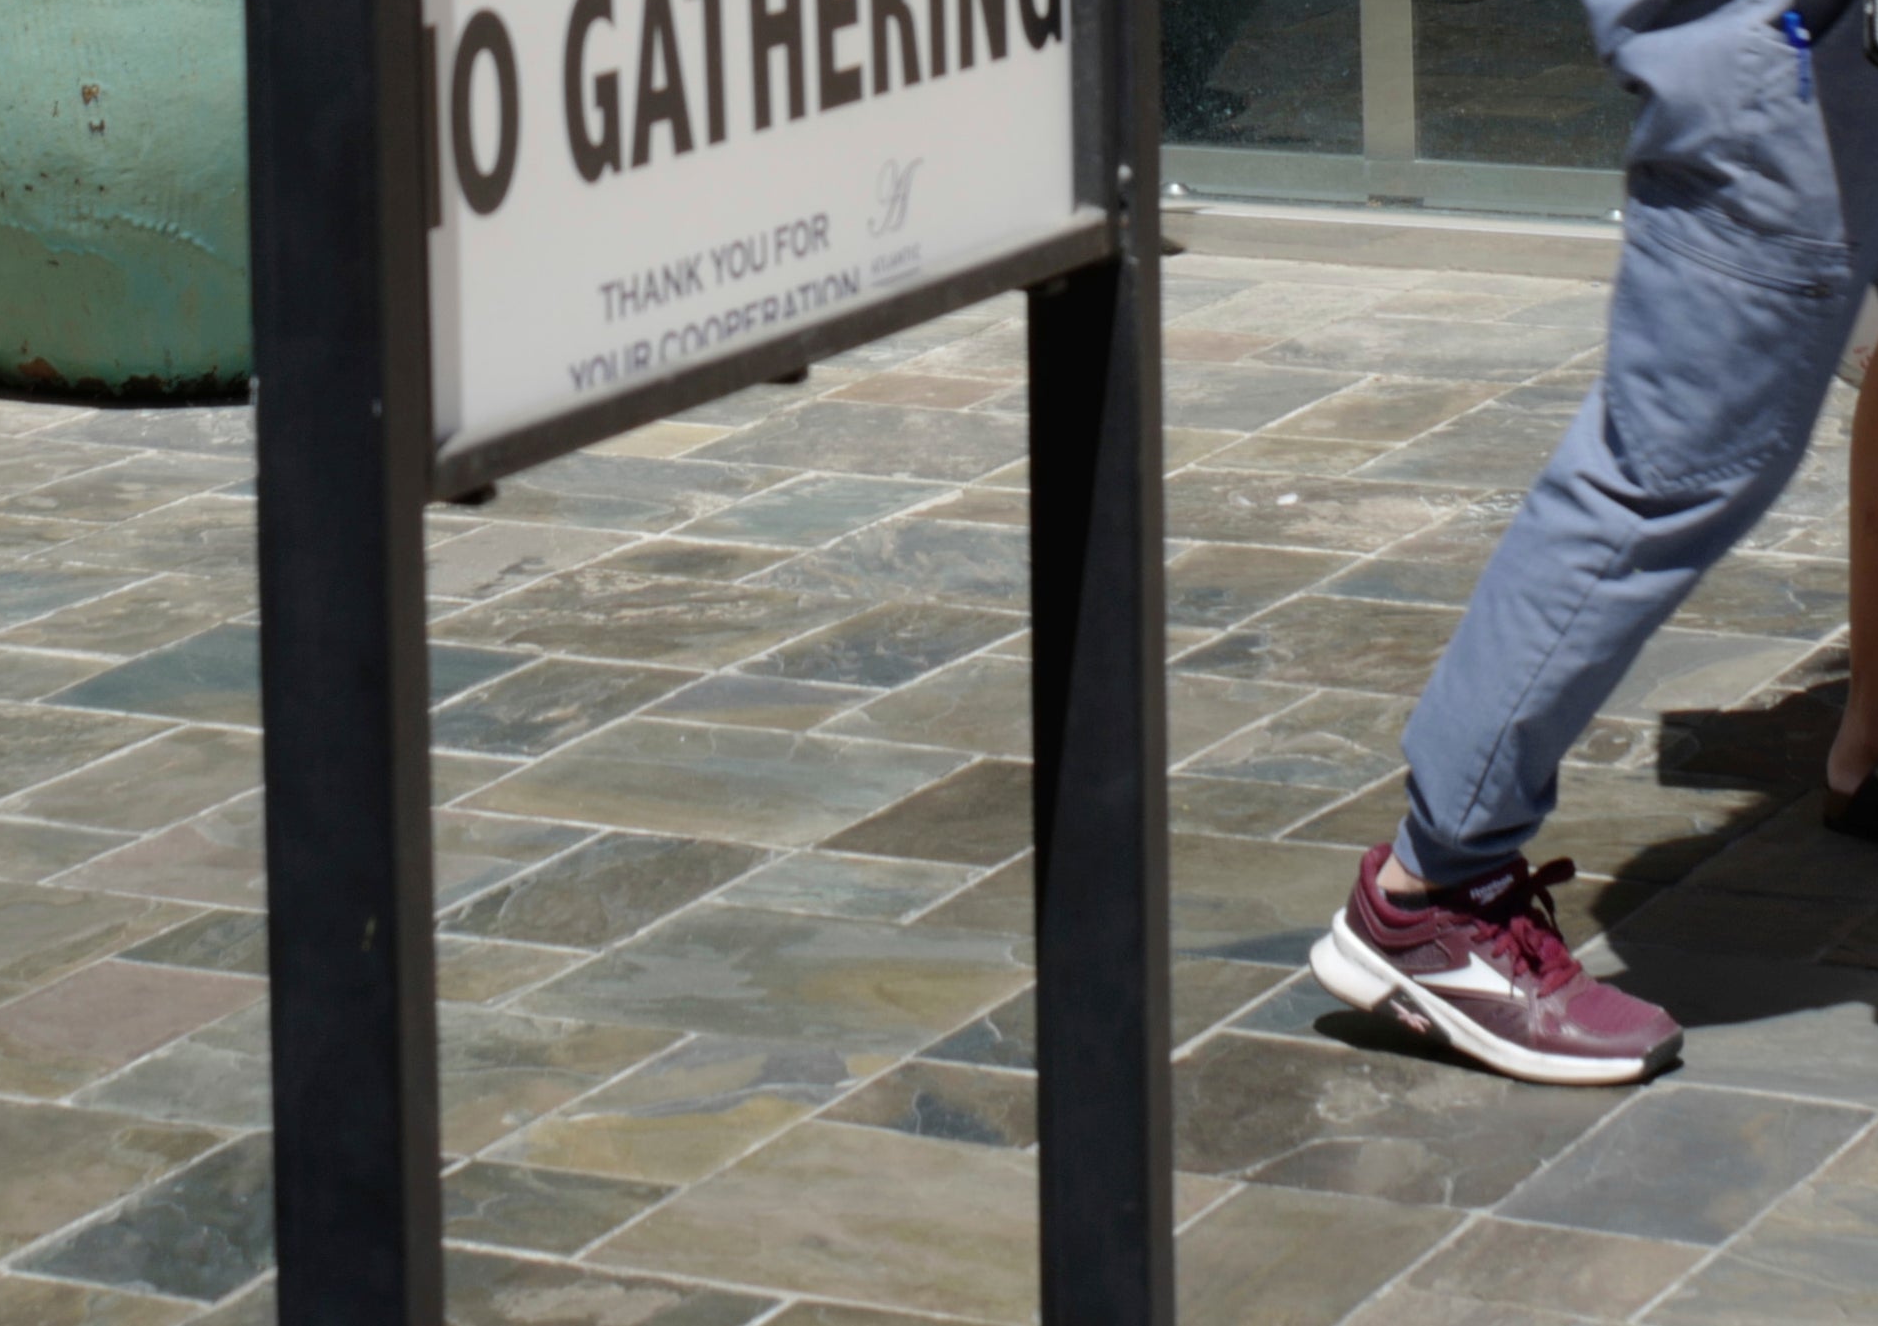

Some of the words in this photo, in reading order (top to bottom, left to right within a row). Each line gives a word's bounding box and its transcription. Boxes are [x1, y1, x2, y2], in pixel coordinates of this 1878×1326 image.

[599, 251, 705, 323] THANK
[710, 232, 769, 284] YOU
[774, 212, 830, 266] FOR
